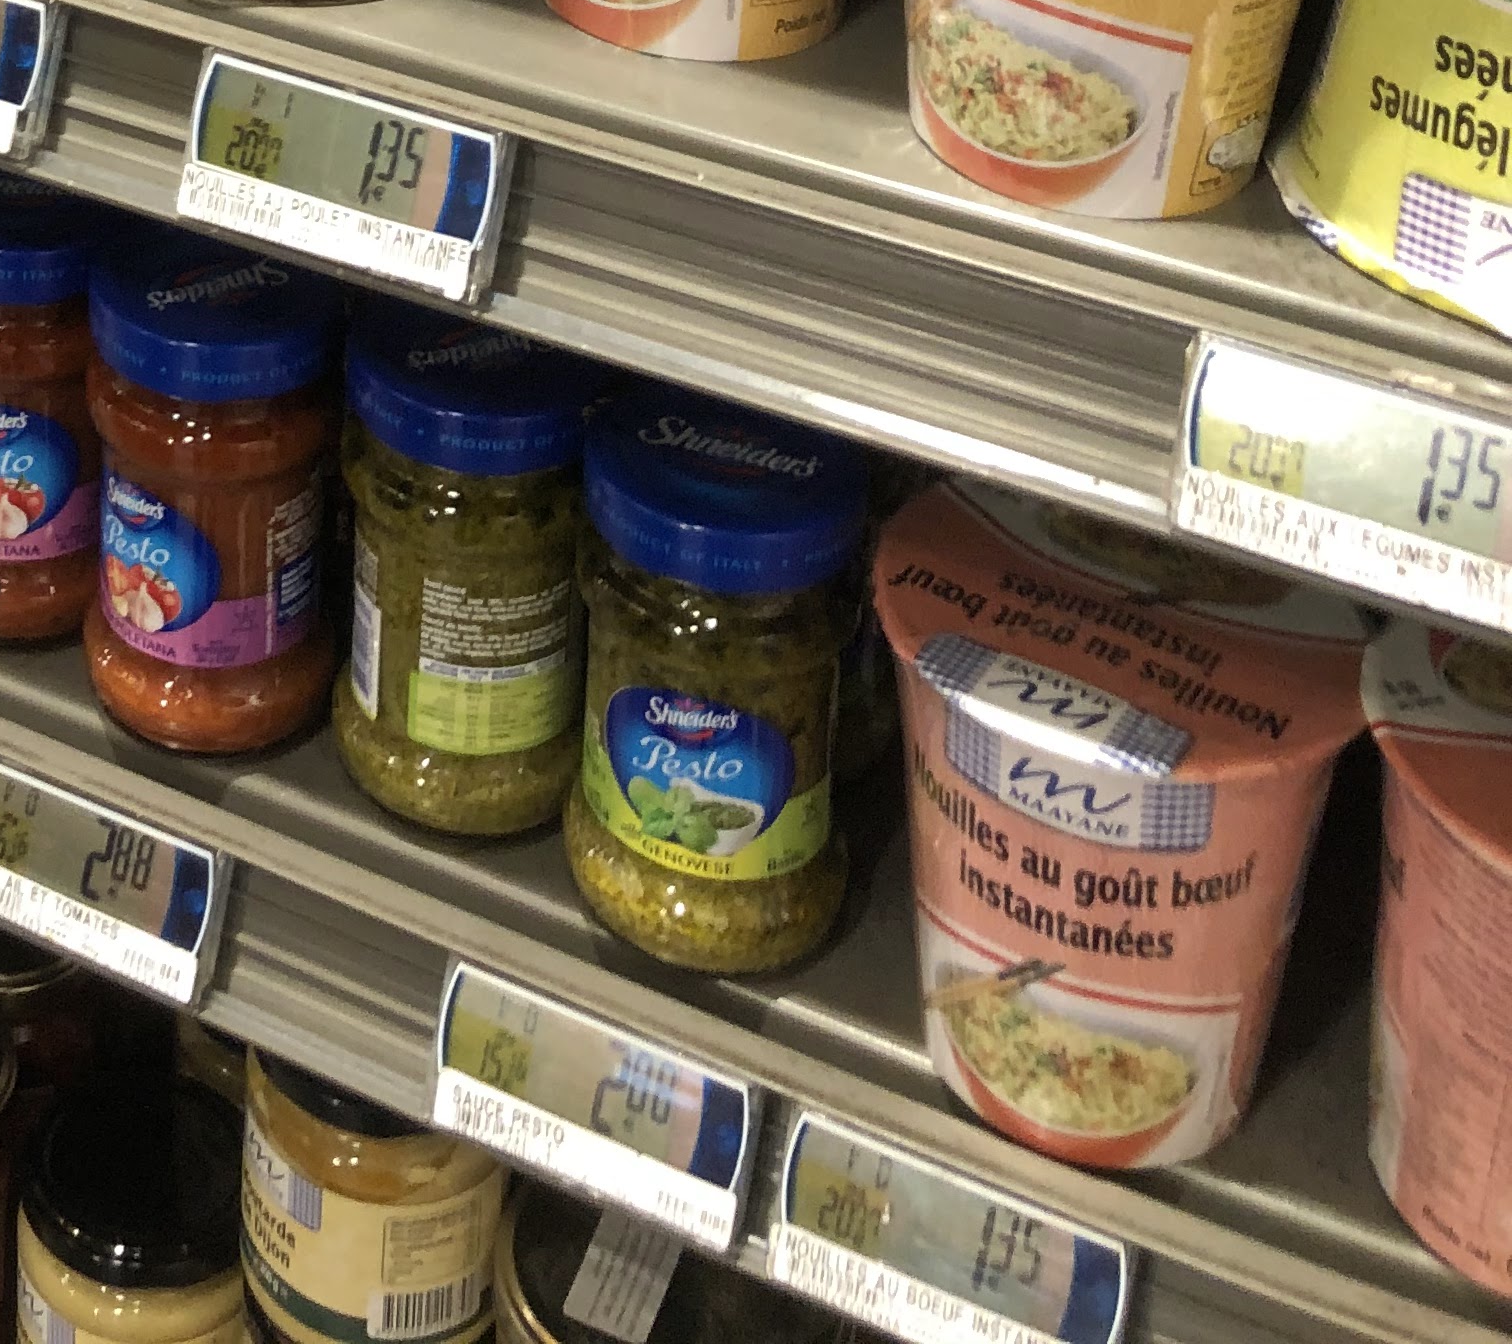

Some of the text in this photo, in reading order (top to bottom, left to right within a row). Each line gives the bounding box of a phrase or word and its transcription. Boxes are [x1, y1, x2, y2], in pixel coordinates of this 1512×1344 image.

[184, 170, 255, 205] NOUILLES
[291, 196, 349, 229] POULET
[633, 736, 743, 781] Pesto
[1008, 786, 1128, 838] MAAYANE
[1021, 837, 1060, 884] au
[1075, 866, 1158, 909] goût
[54, 896, 120, 940] TOMATES
[961, 850, 1175, 960] instantanées
